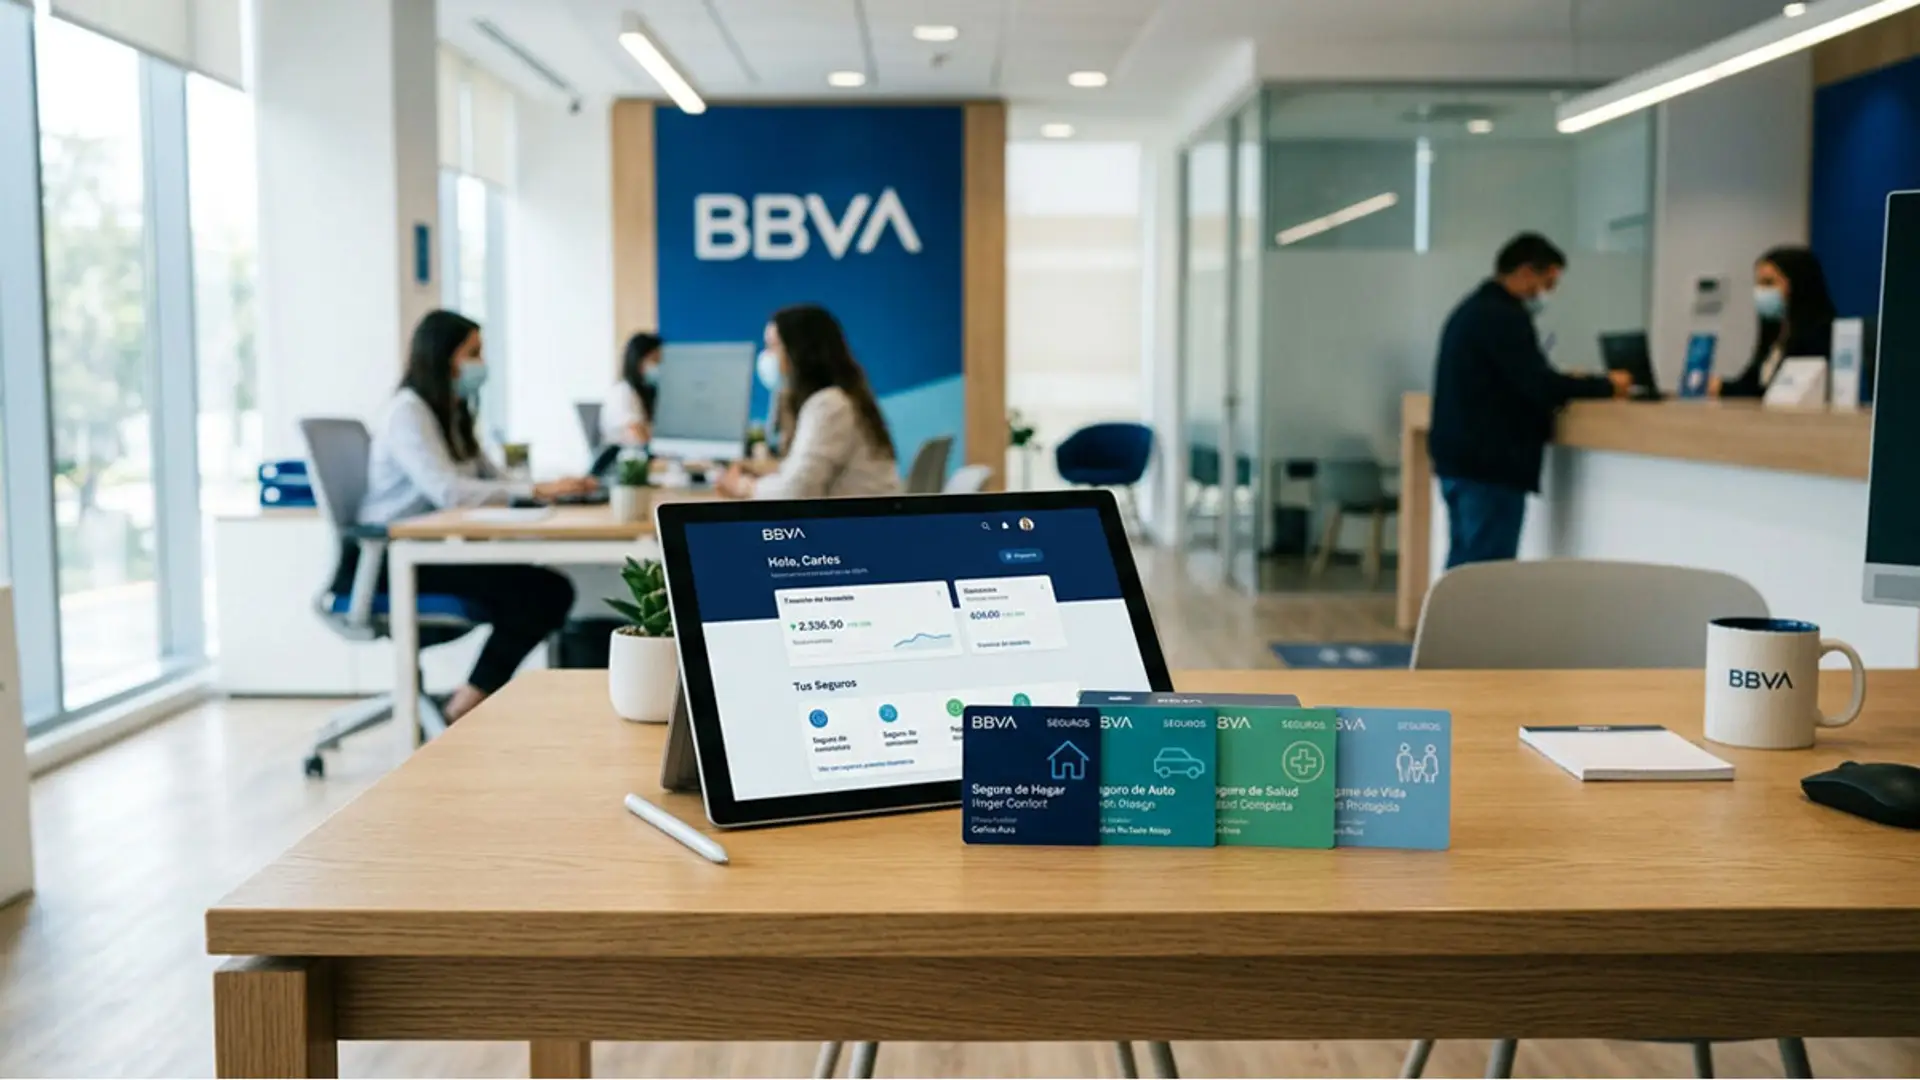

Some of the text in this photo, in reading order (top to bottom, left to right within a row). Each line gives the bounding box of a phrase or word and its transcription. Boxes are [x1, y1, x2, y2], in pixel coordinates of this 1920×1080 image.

[694, 186, 922, 260] BBVA
[762, 527, 806, 540] BBVA
[792, 680, 857, 691] Tus Seguros
[1728, 669, 1793, 690] BBVA
[972, 715, 1018, 729] BBVA
[1100, 716, 1133, 729] BVA
[1217, 716, 1252, 729] BVA
[1335, 717, 1366, 731] BVA
[1014, 784, 1029, 795] de
[1131, 784, 1146, 796] de
[1148, 785, 1176, 796] Auto
[1248, 785, 1263, 796] de
[1265, 786, 1299, 797] Salud
